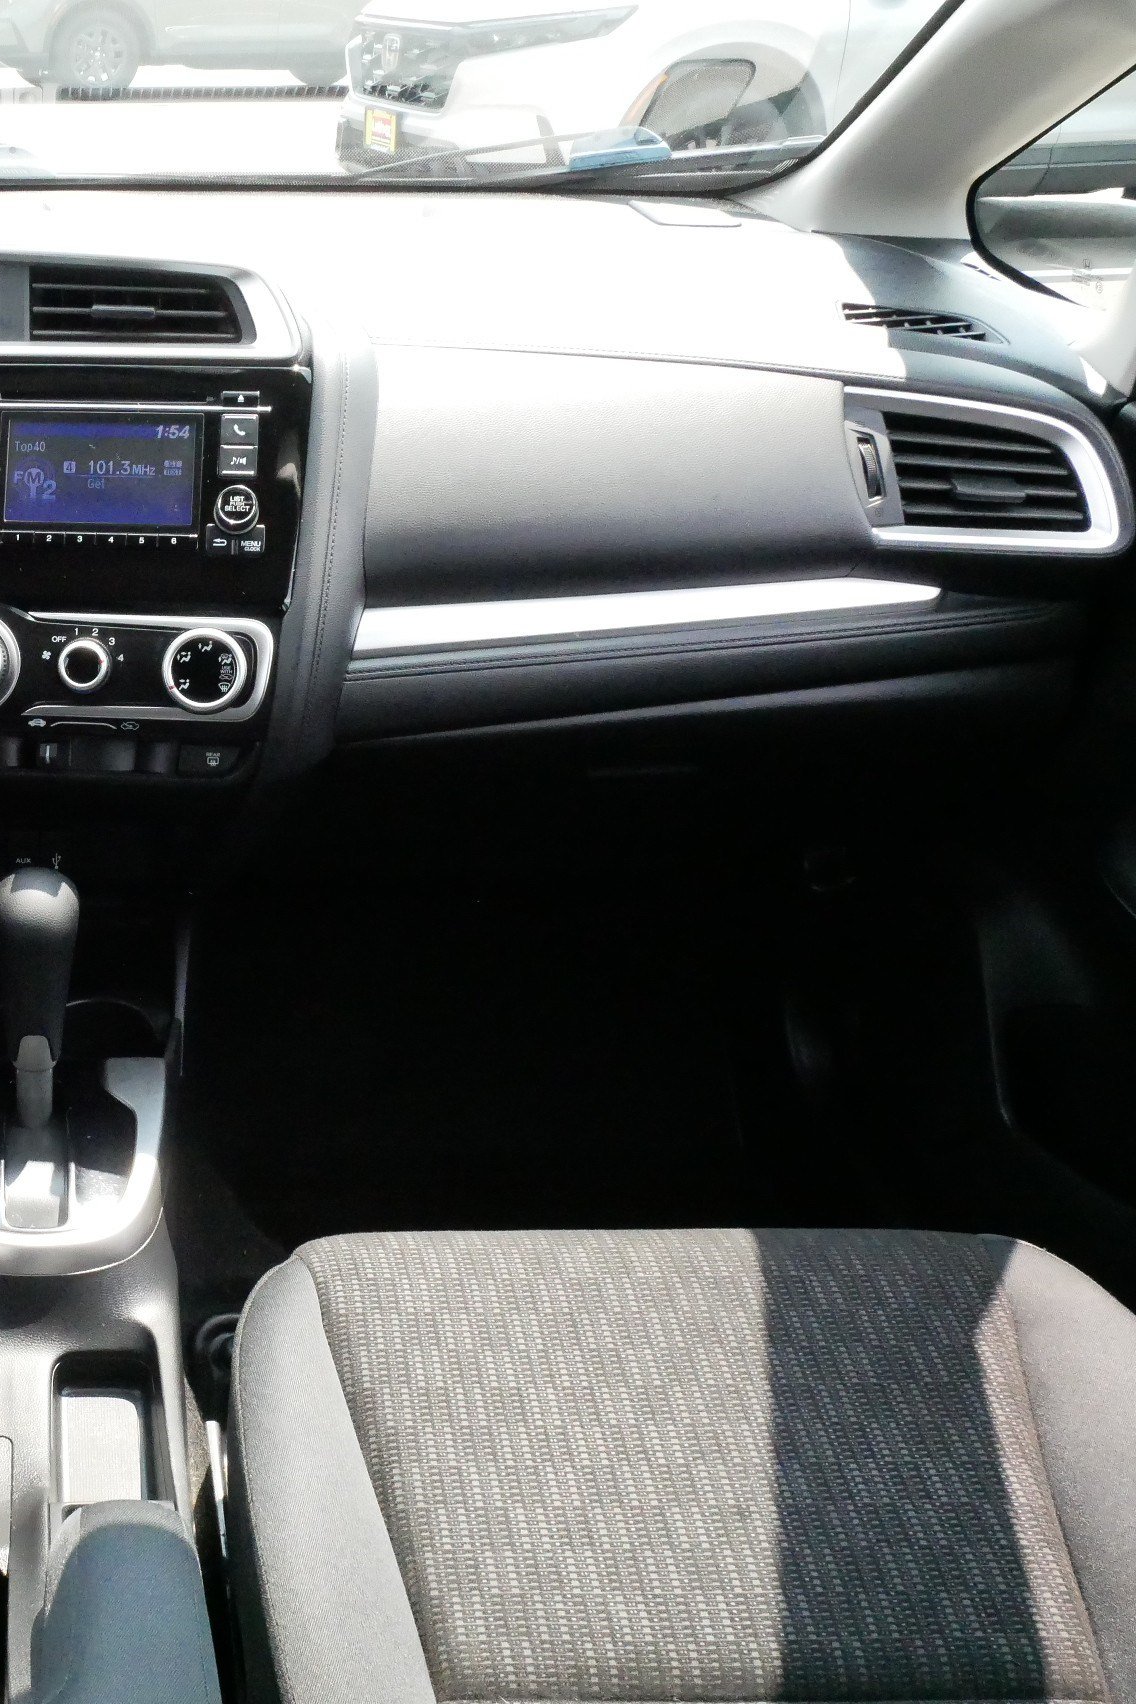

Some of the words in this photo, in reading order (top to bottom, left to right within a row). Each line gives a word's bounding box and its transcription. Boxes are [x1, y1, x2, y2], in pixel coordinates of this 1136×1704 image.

[155, 424, 190, 440] 1:54
[14, 440, 46, 453] Top40
[74, 627, 79, 636] 1
[91, 627, 99, 636] 2
[108, 637, 116, 646] 3
[116, 653, 124, 662] 4
